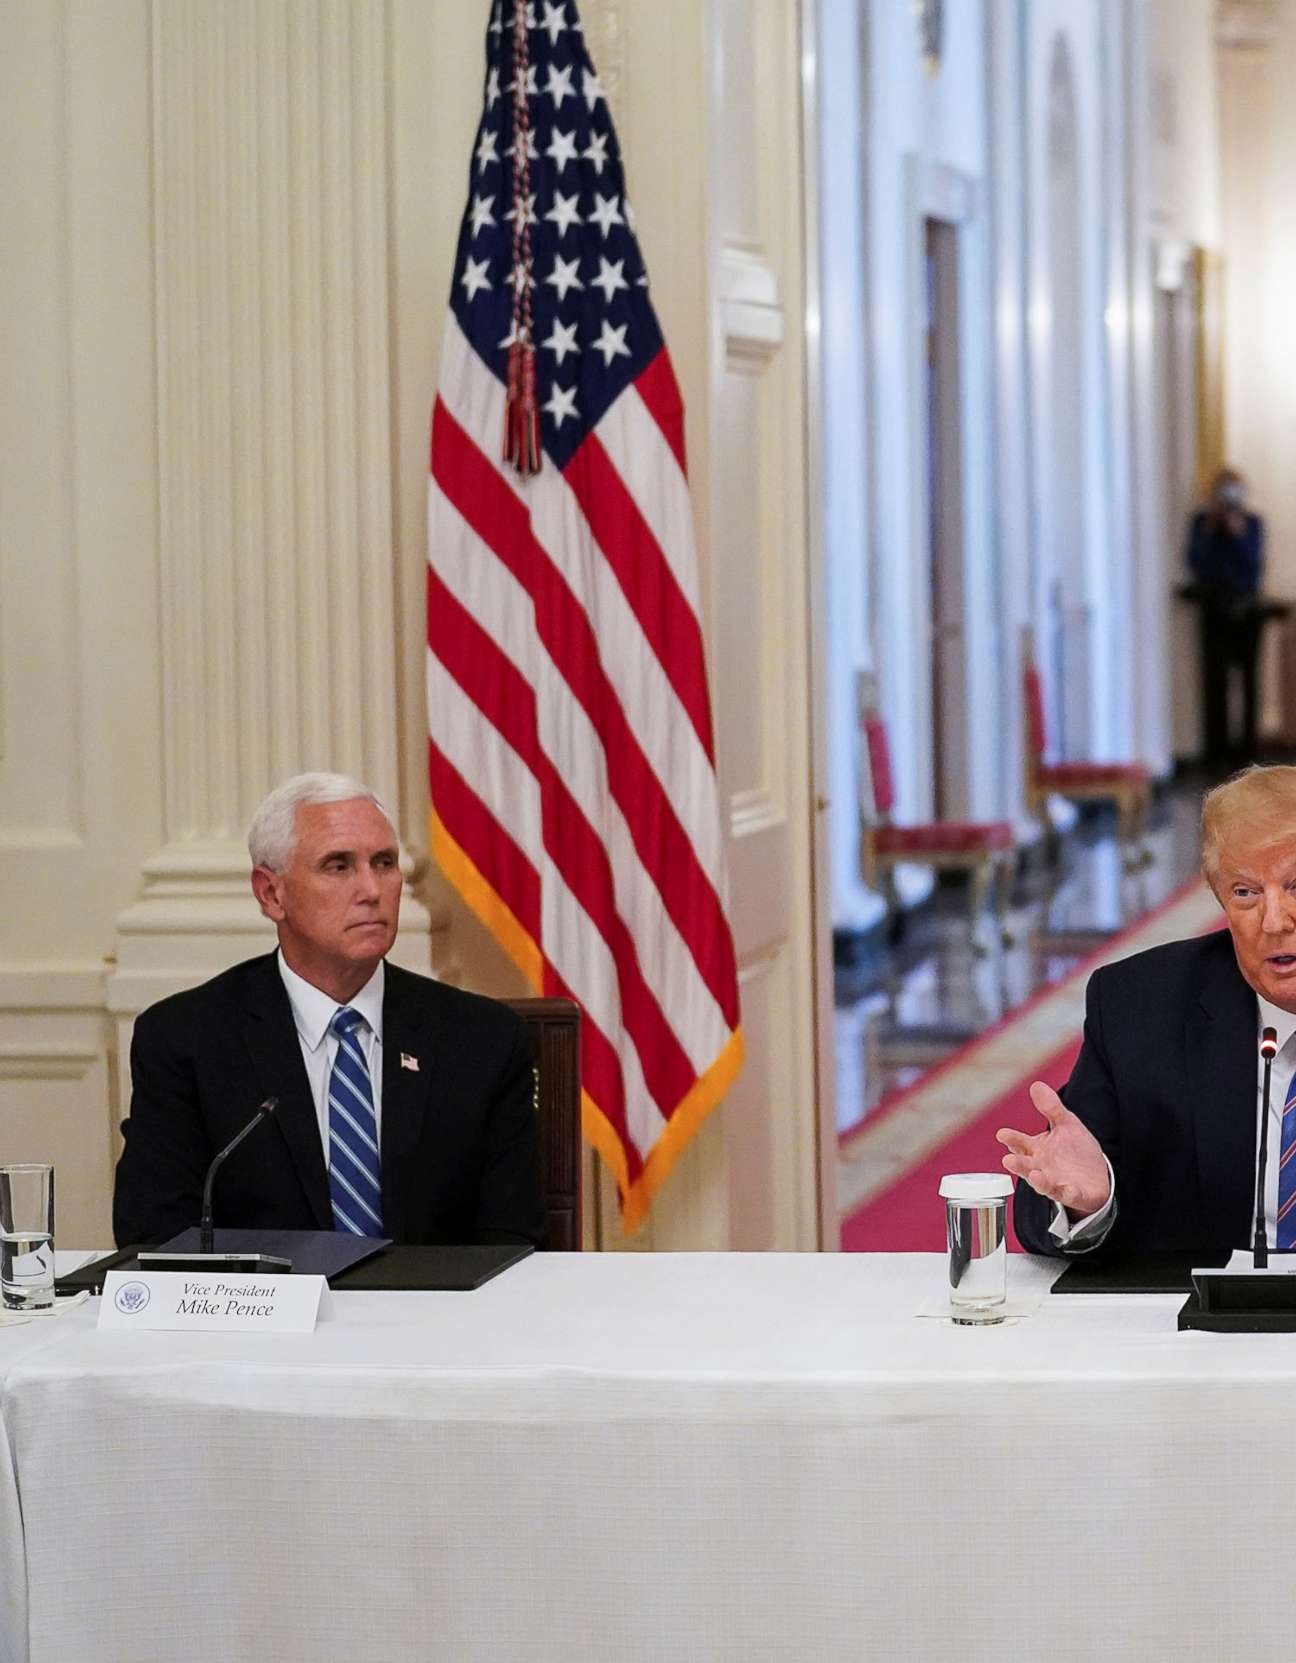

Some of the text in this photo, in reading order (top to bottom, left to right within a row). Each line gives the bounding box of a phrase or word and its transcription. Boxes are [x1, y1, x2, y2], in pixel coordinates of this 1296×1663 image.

[183, 1283, 276, 1297] Vice President
[176, 1299, 275, 1316] Mike Pence
